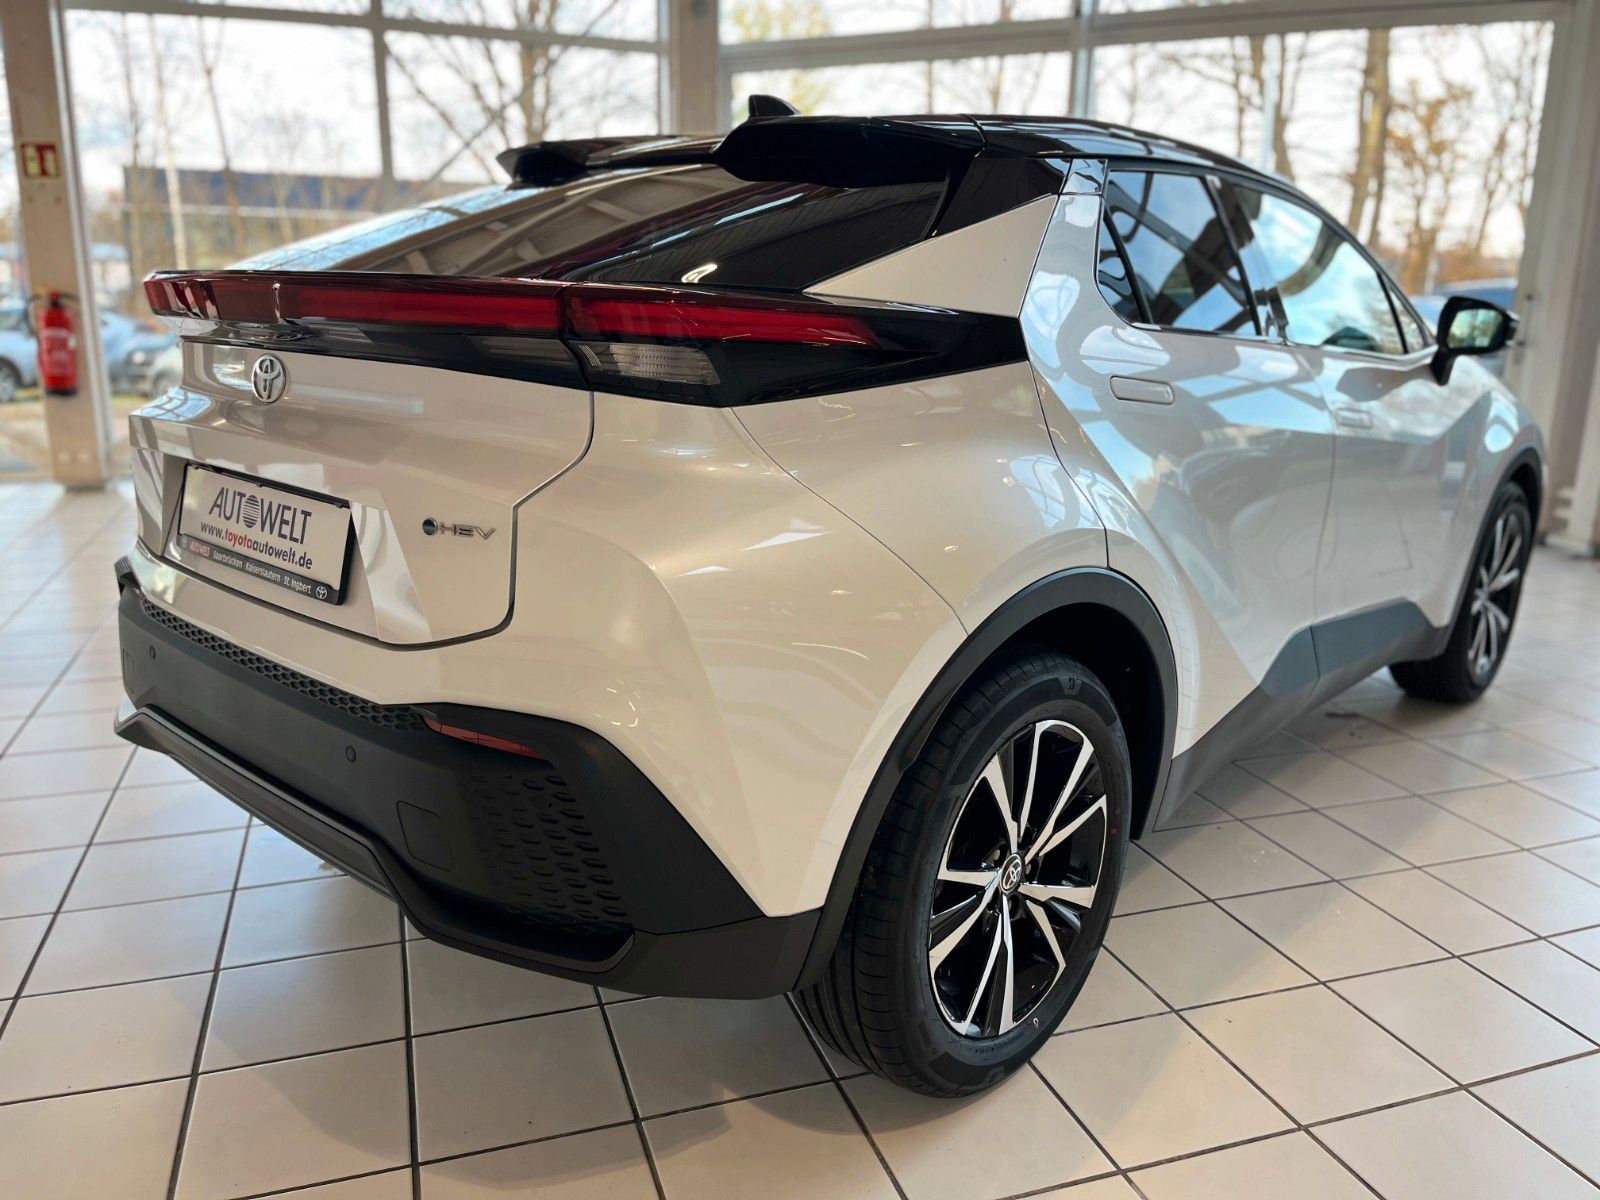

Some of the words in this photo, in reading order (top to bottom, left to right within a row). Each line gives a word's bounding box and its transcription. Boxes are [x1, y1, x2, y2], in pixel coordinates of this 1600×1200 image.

[208, 486, 313, 545] AUTOWELT
[439, 521, 497, 540] HEV
[200, 520, 313, 570] www.toyotaautowelt.de
[291, 578, 312, 594] Ingbert
